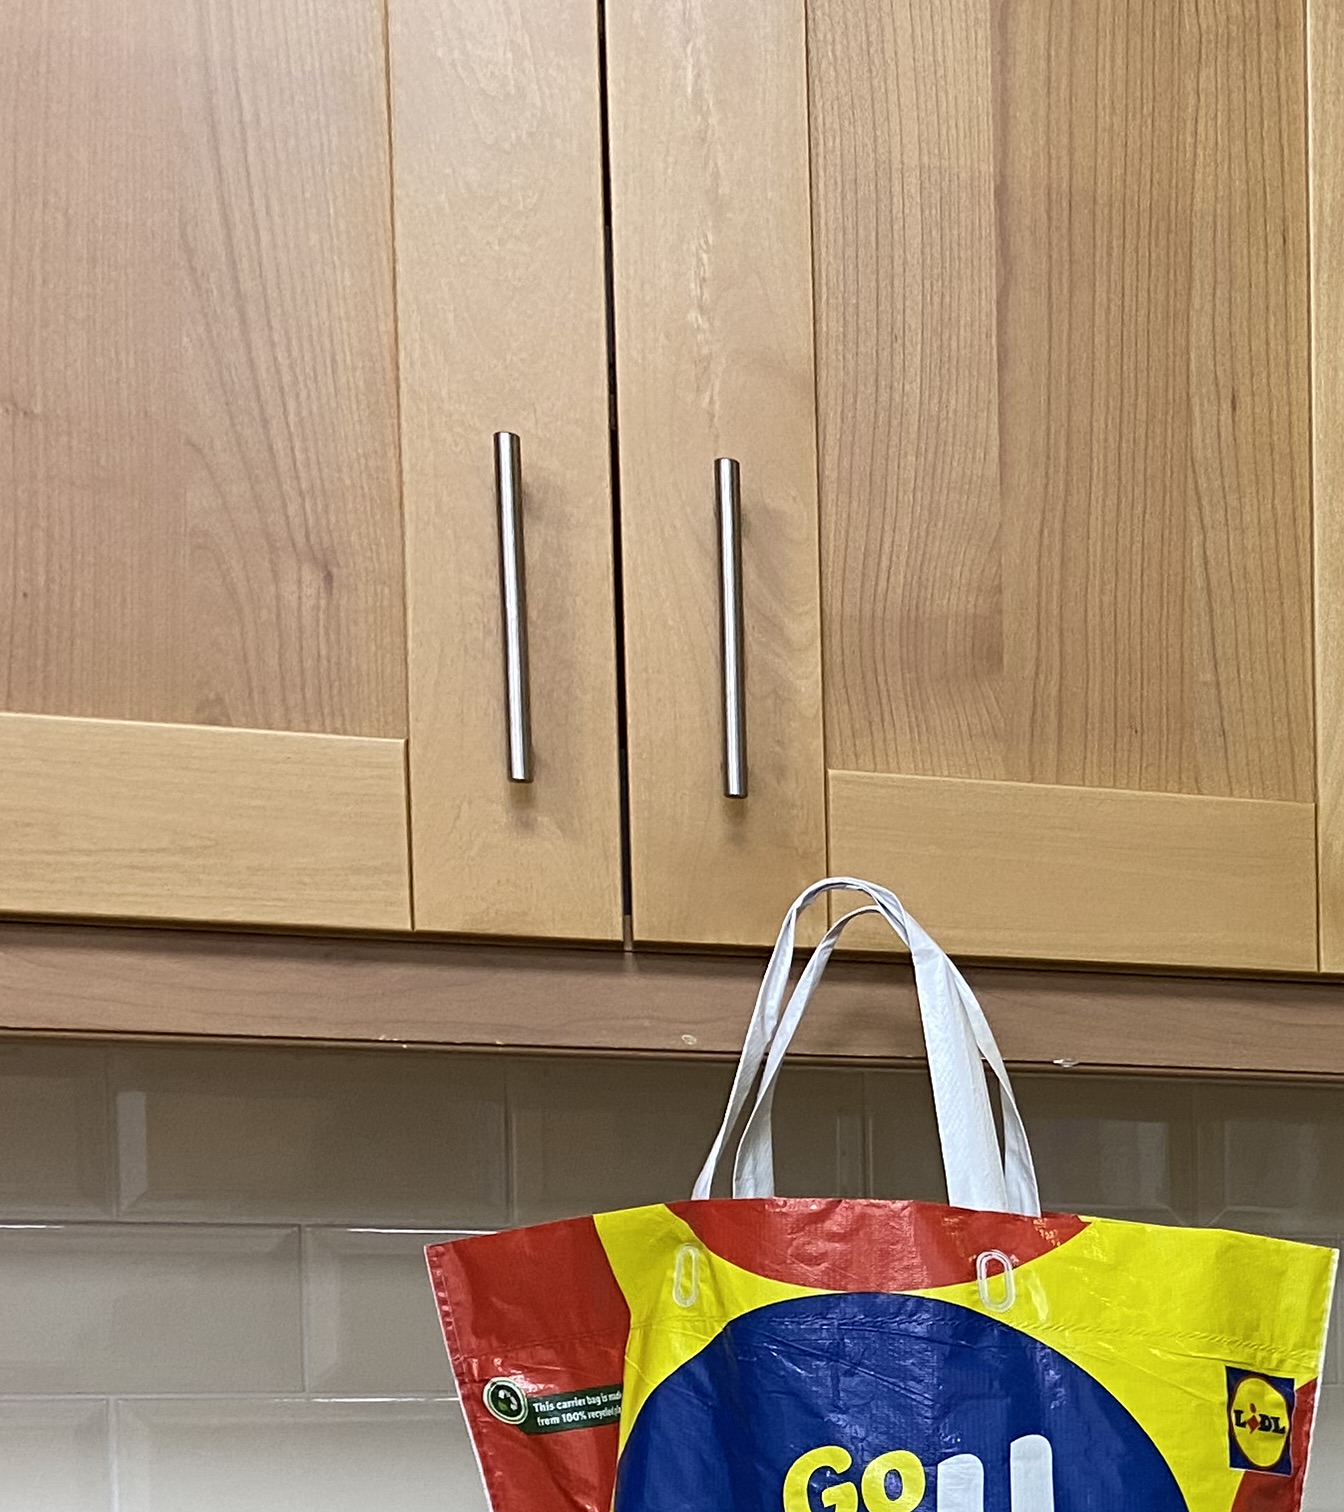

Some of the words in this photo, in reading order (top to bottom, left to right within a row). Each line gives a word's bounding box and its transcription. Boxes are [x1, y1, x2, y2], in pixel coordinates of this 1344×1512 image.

[532, 1400, 556, 1413] This
[555, 1395, 587, 1410] carrier
[586, 1394, 602, 1406] bag
[600, 1391, 608, 1403] is
[536, 1414, 560, 1427] from
[560, 1410, 588, 1424] 100%
